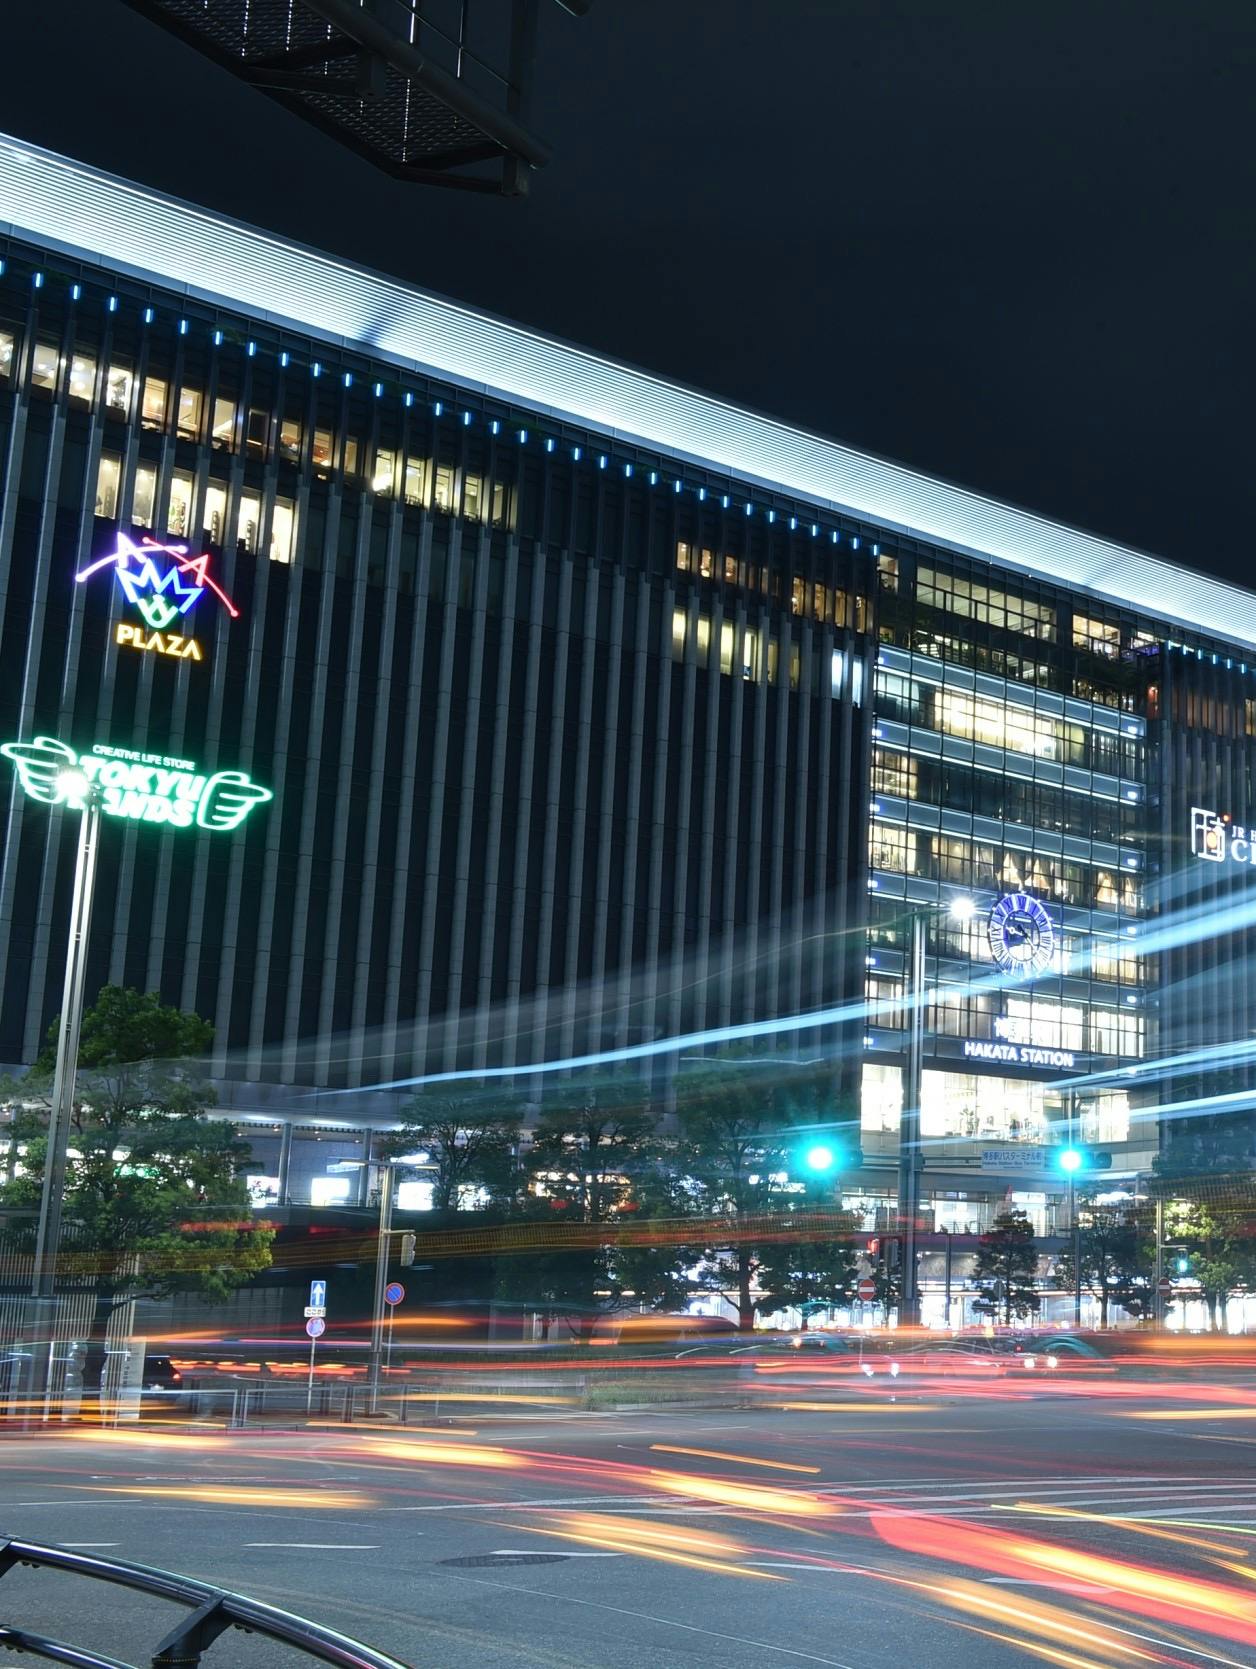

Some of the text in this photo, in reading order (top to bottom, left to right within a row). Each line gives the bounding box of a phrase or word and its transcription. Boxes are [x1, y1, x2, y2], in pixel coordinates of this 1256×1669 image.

[116, 623, 202, 661] PLAZA
[92, 744, 196, 771] CREATIVE LIFE STORE
[80, 755, 206, 802] TOKYU
[1232, 825, 1245, 840] JR
[964, 1041, 1074, 1068] HAKATA STATION
